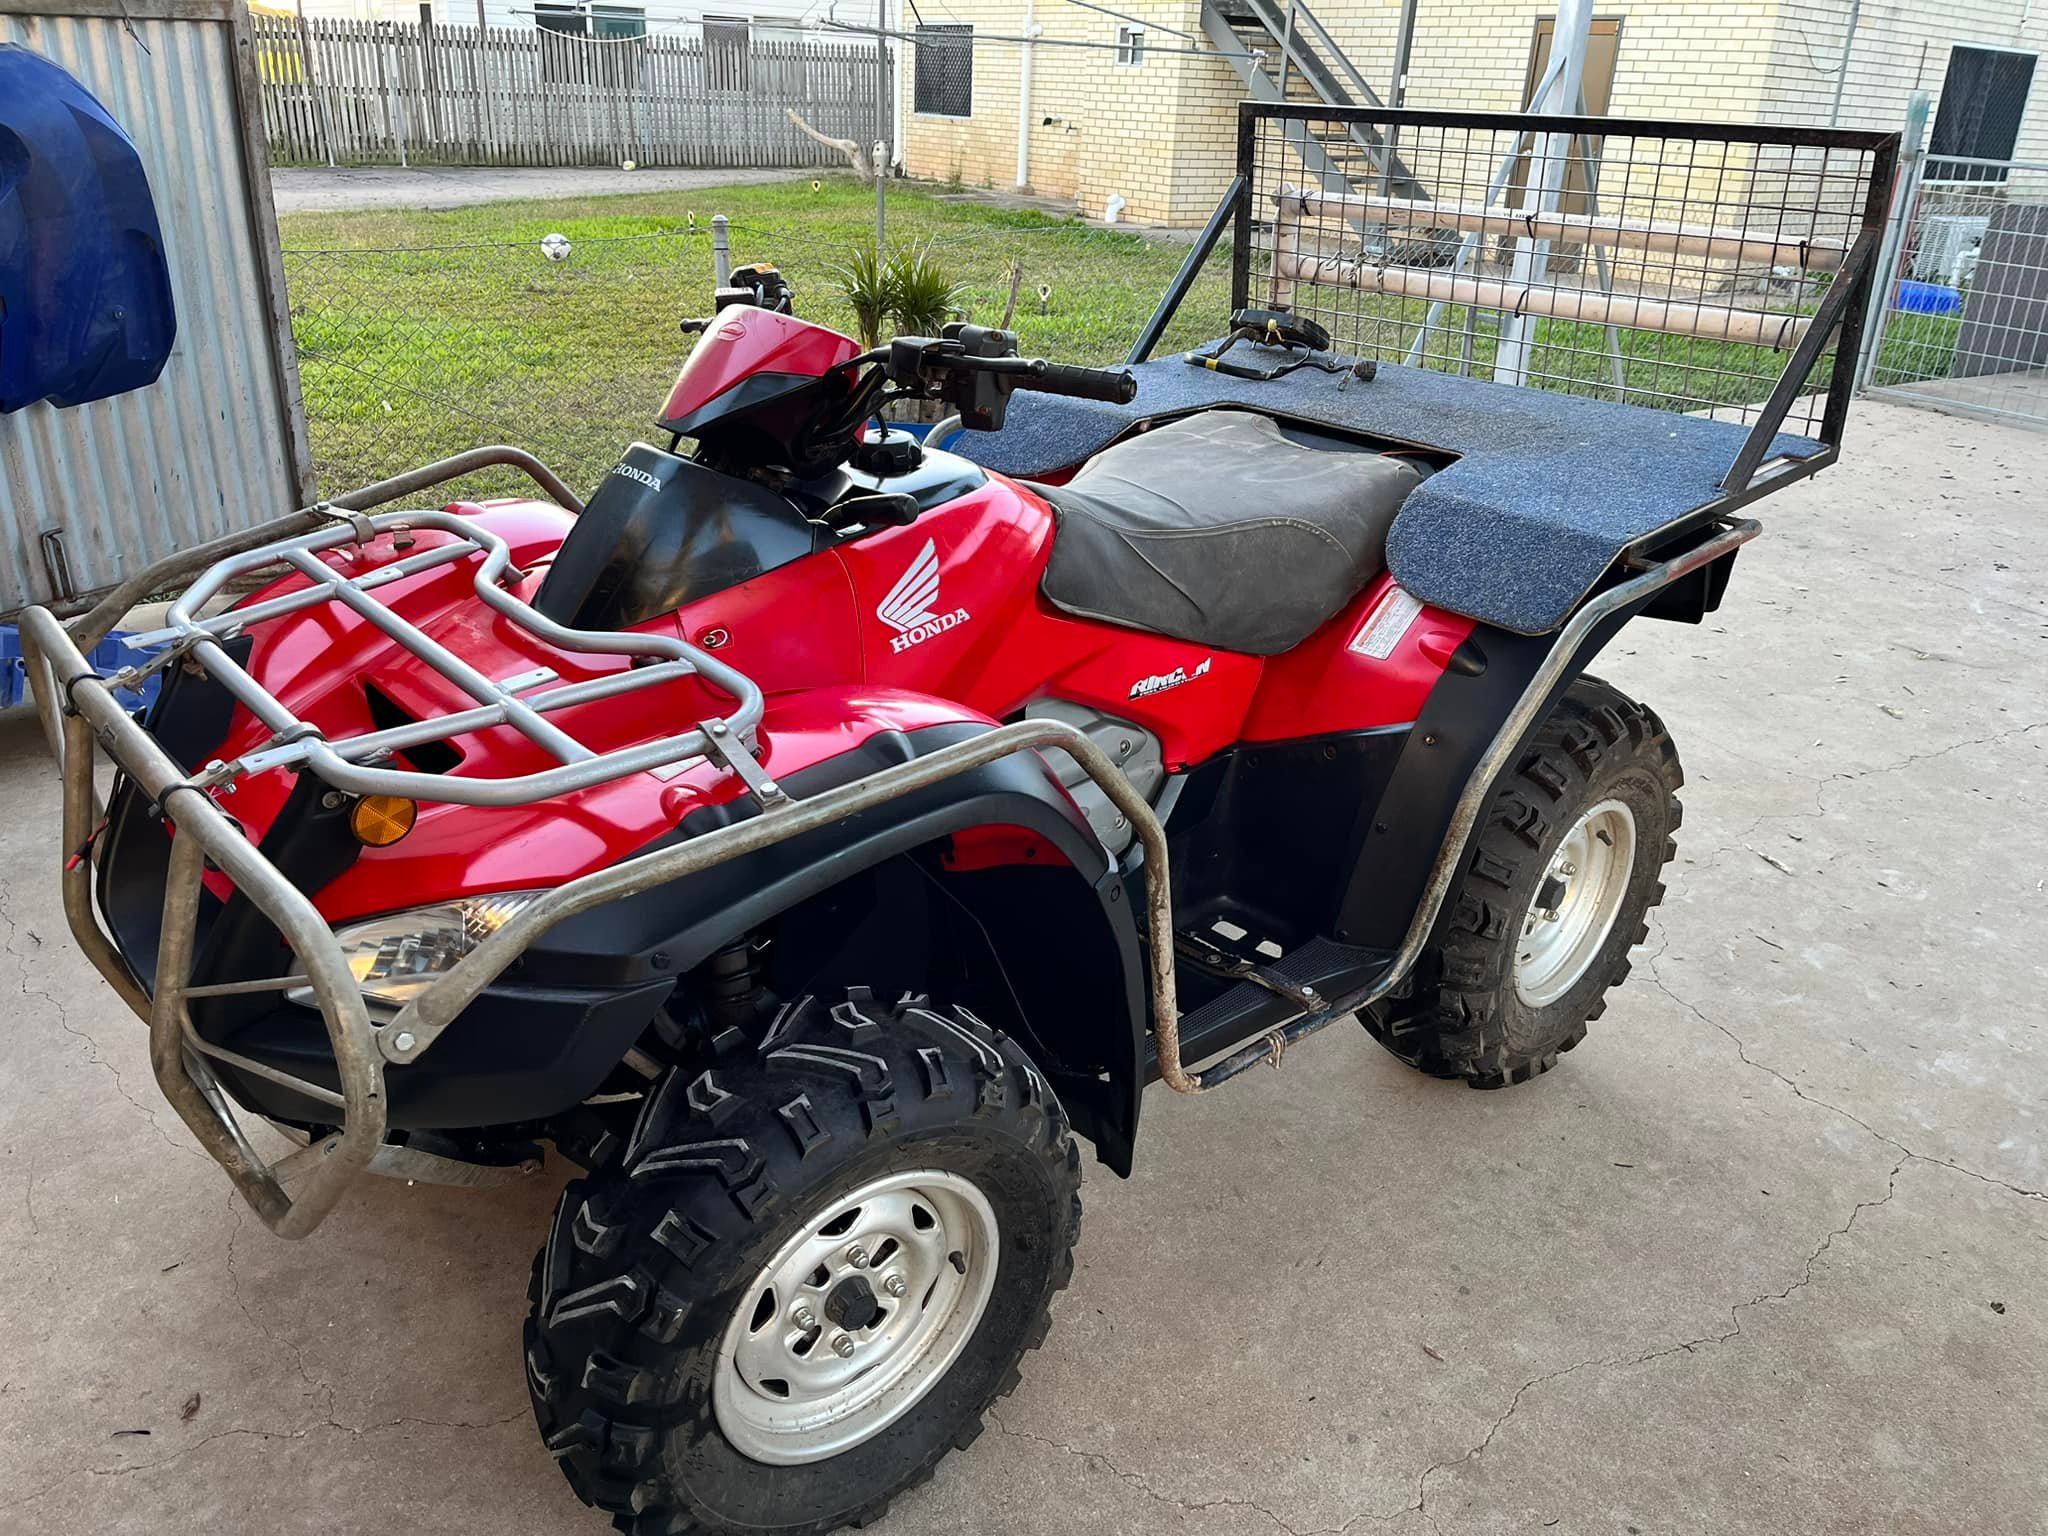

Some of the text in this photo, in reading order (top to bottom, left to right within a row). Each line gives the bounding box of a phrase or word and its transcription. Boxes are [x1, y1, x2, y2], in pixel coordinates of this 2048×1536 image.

[612, 462, 662, 492] HONDA
[889, 607, 971, 654] HONDA
[1129, 656, 1212, 697] RINCN
